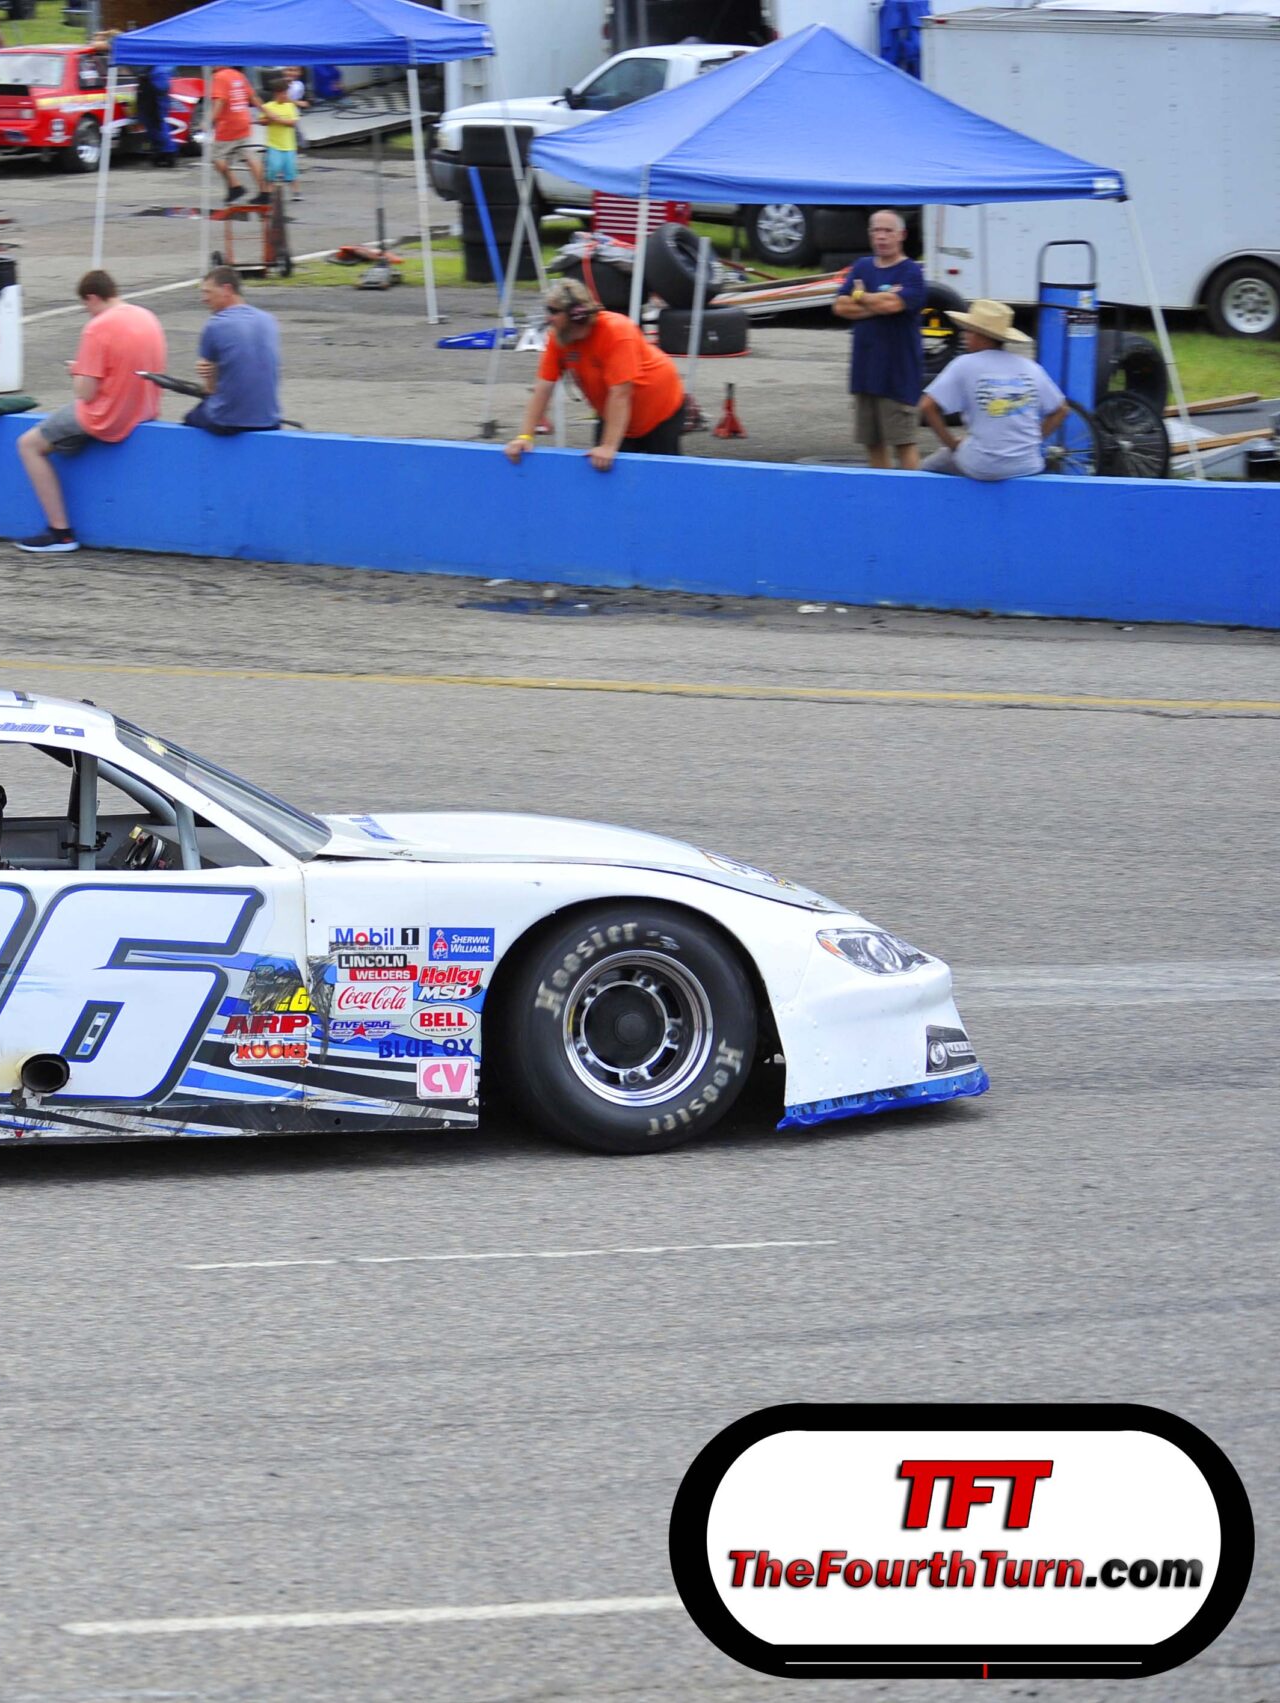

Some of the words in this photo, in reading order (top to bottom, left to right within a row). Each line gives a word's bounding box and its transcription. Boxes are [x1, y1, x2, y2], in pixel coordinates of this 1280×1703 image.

[335, 928, 394, 945] Mobil
[450, 934, 490, 944] SHERWIN
[341, 955, 404, 968] LINCOLN
[355, 970, 410, 980] WELDERS
[420, 966, 483, 988] Holley
[534, 922, 638, 1019] Hoosier
[418, 985, 473, 1001] MSD
[223, 1015, 310, 1034] ARP
[363, 1020, 392, 1030] STAR
[419, 1013, 468, 1027] BELL
[236, 1044, 308, 1059] KOOKS
[379, 1040, 433, 1059] BLUE
[442, 1039, 473, 1057] OX
[422, 1063, 469, 1093] CV
